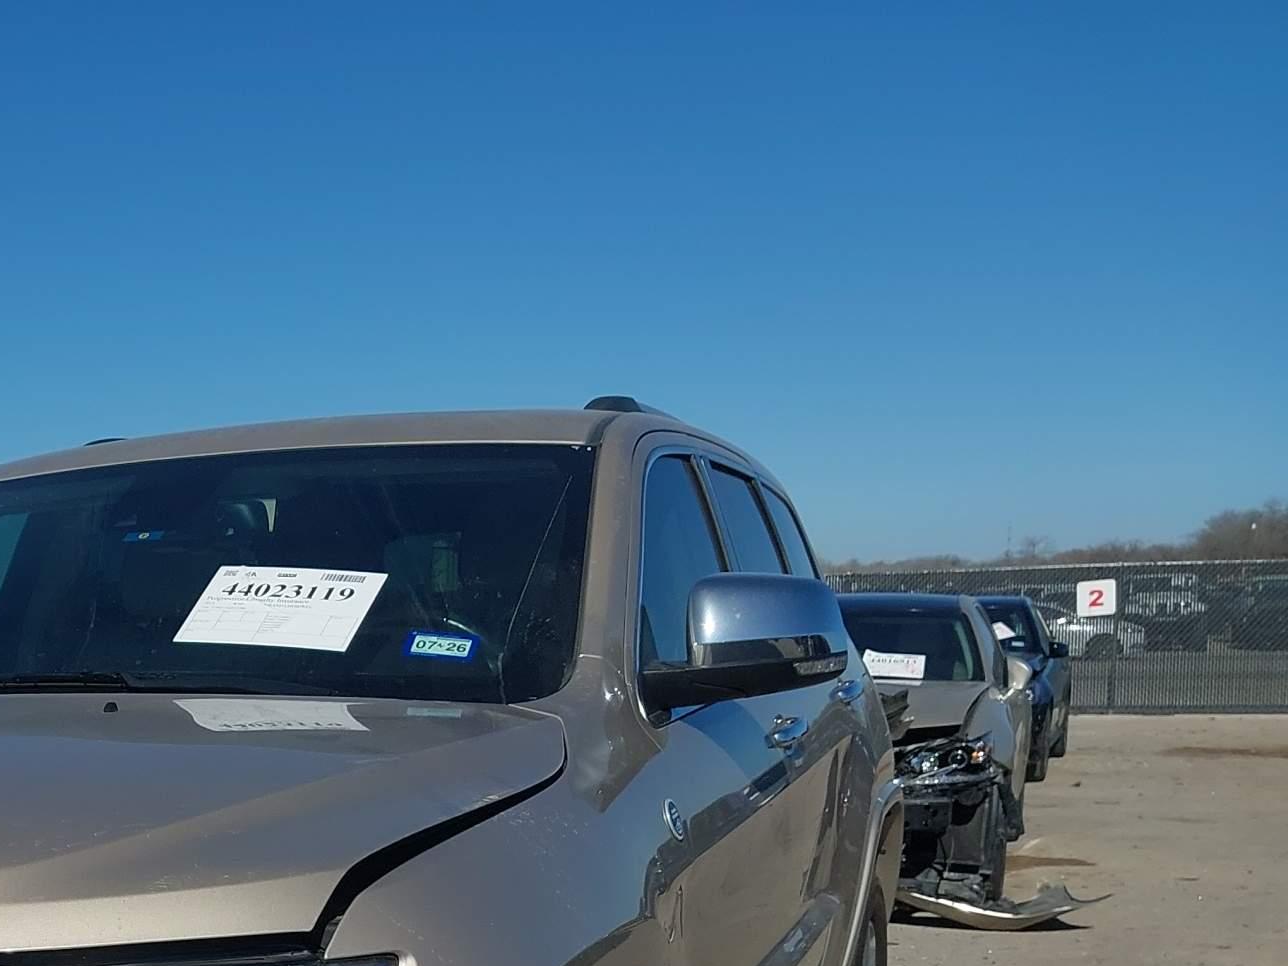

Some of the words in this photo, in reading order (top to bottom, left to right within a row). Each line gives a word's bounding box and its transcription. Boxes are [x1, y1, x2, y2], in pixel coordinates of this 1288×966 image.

[222, 582, 356, 602] 44023119
[1088, 590, 1105, 607] 2
[415, 640, 438, 650] 07
[445, 642, 467, 653] 26
